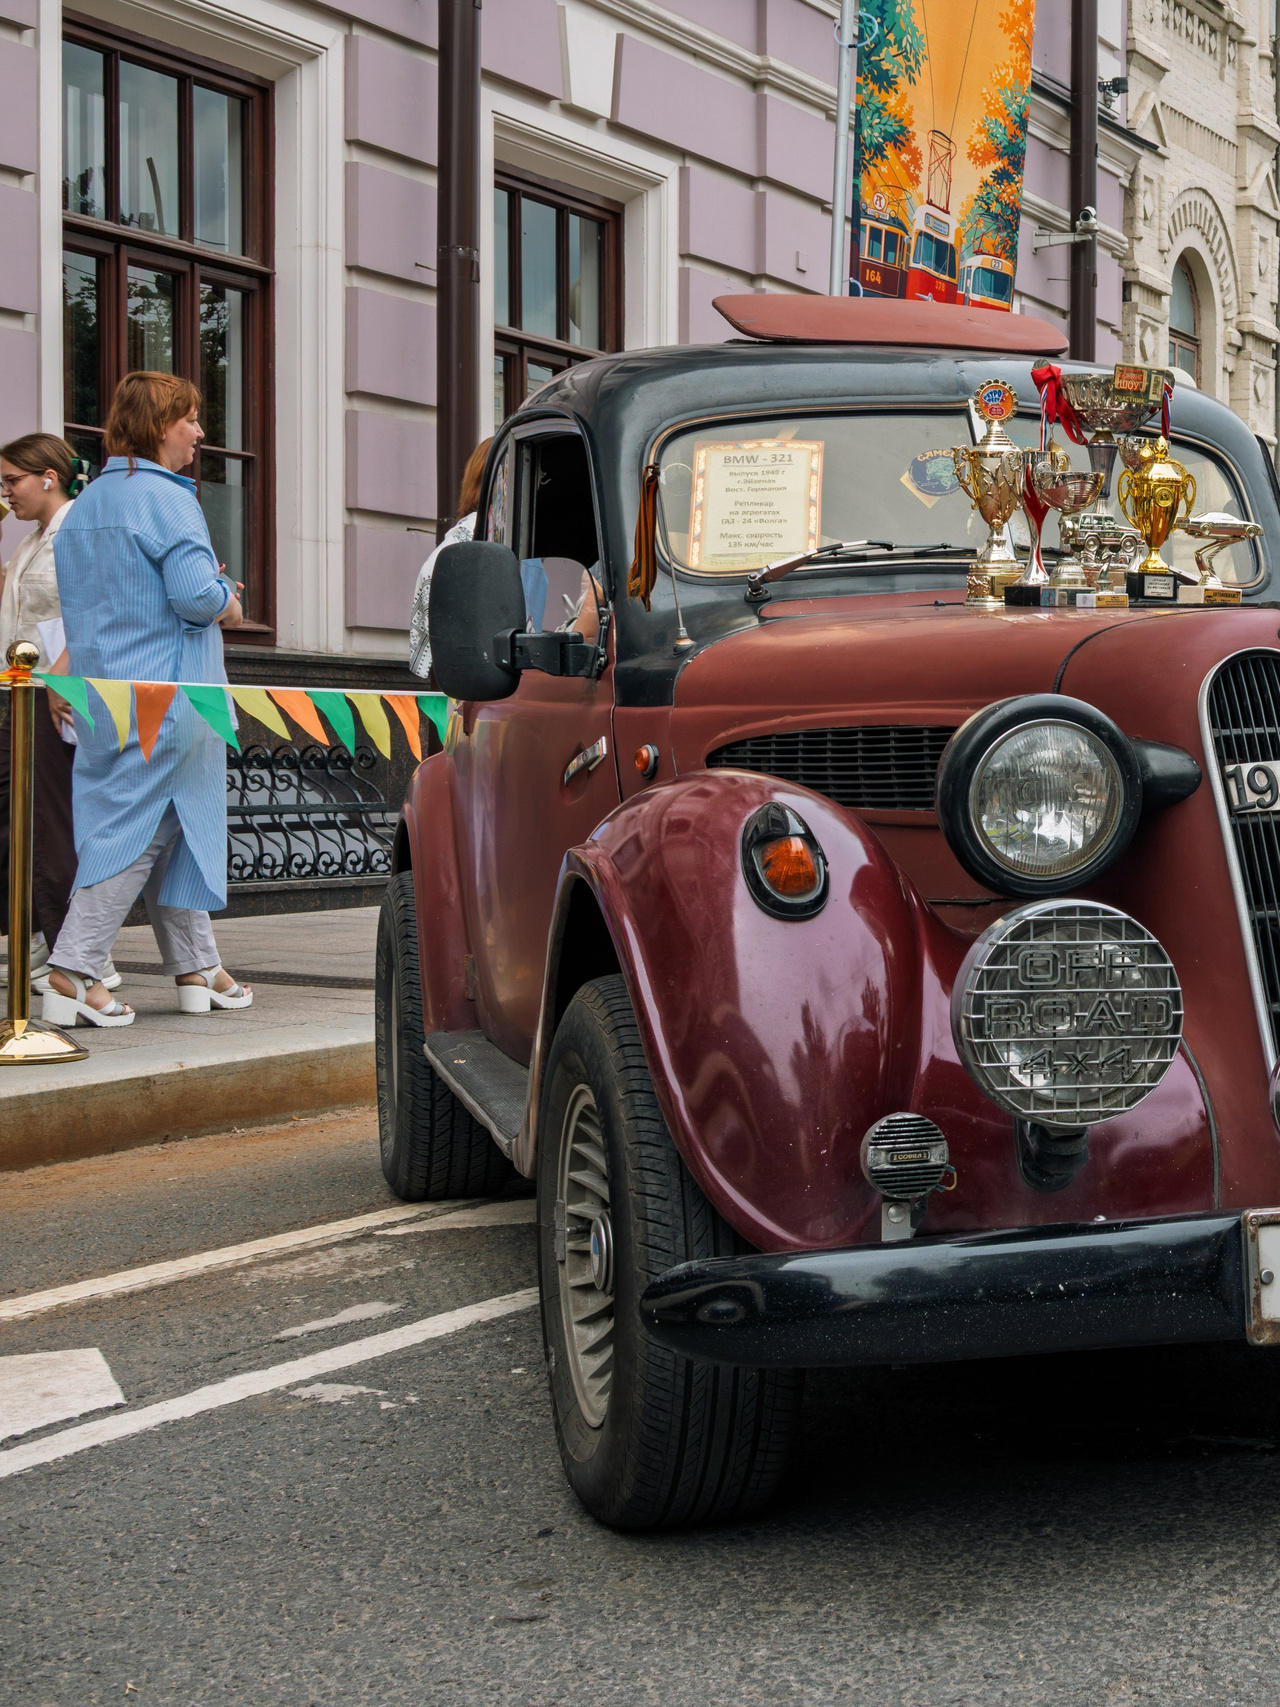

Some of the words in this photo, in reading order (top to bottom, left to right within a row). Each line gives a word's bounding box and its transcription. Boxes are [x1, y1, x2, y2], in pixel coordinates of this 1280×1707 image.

[993, 260, 1001, 269] 23
[865, 268, 882, 284] 164
[935, 280, 946, 292] 378
[1114, 394, 1146, 405] УЧАСТНИК
[724, 454, 759, 464] BMW
[770, 453, 793, 463] 321
[744, 540, 774, 548] км/час
[1017, 948, 1141, 986] OFF
[984, 995, 1174, 1036] ROAD
